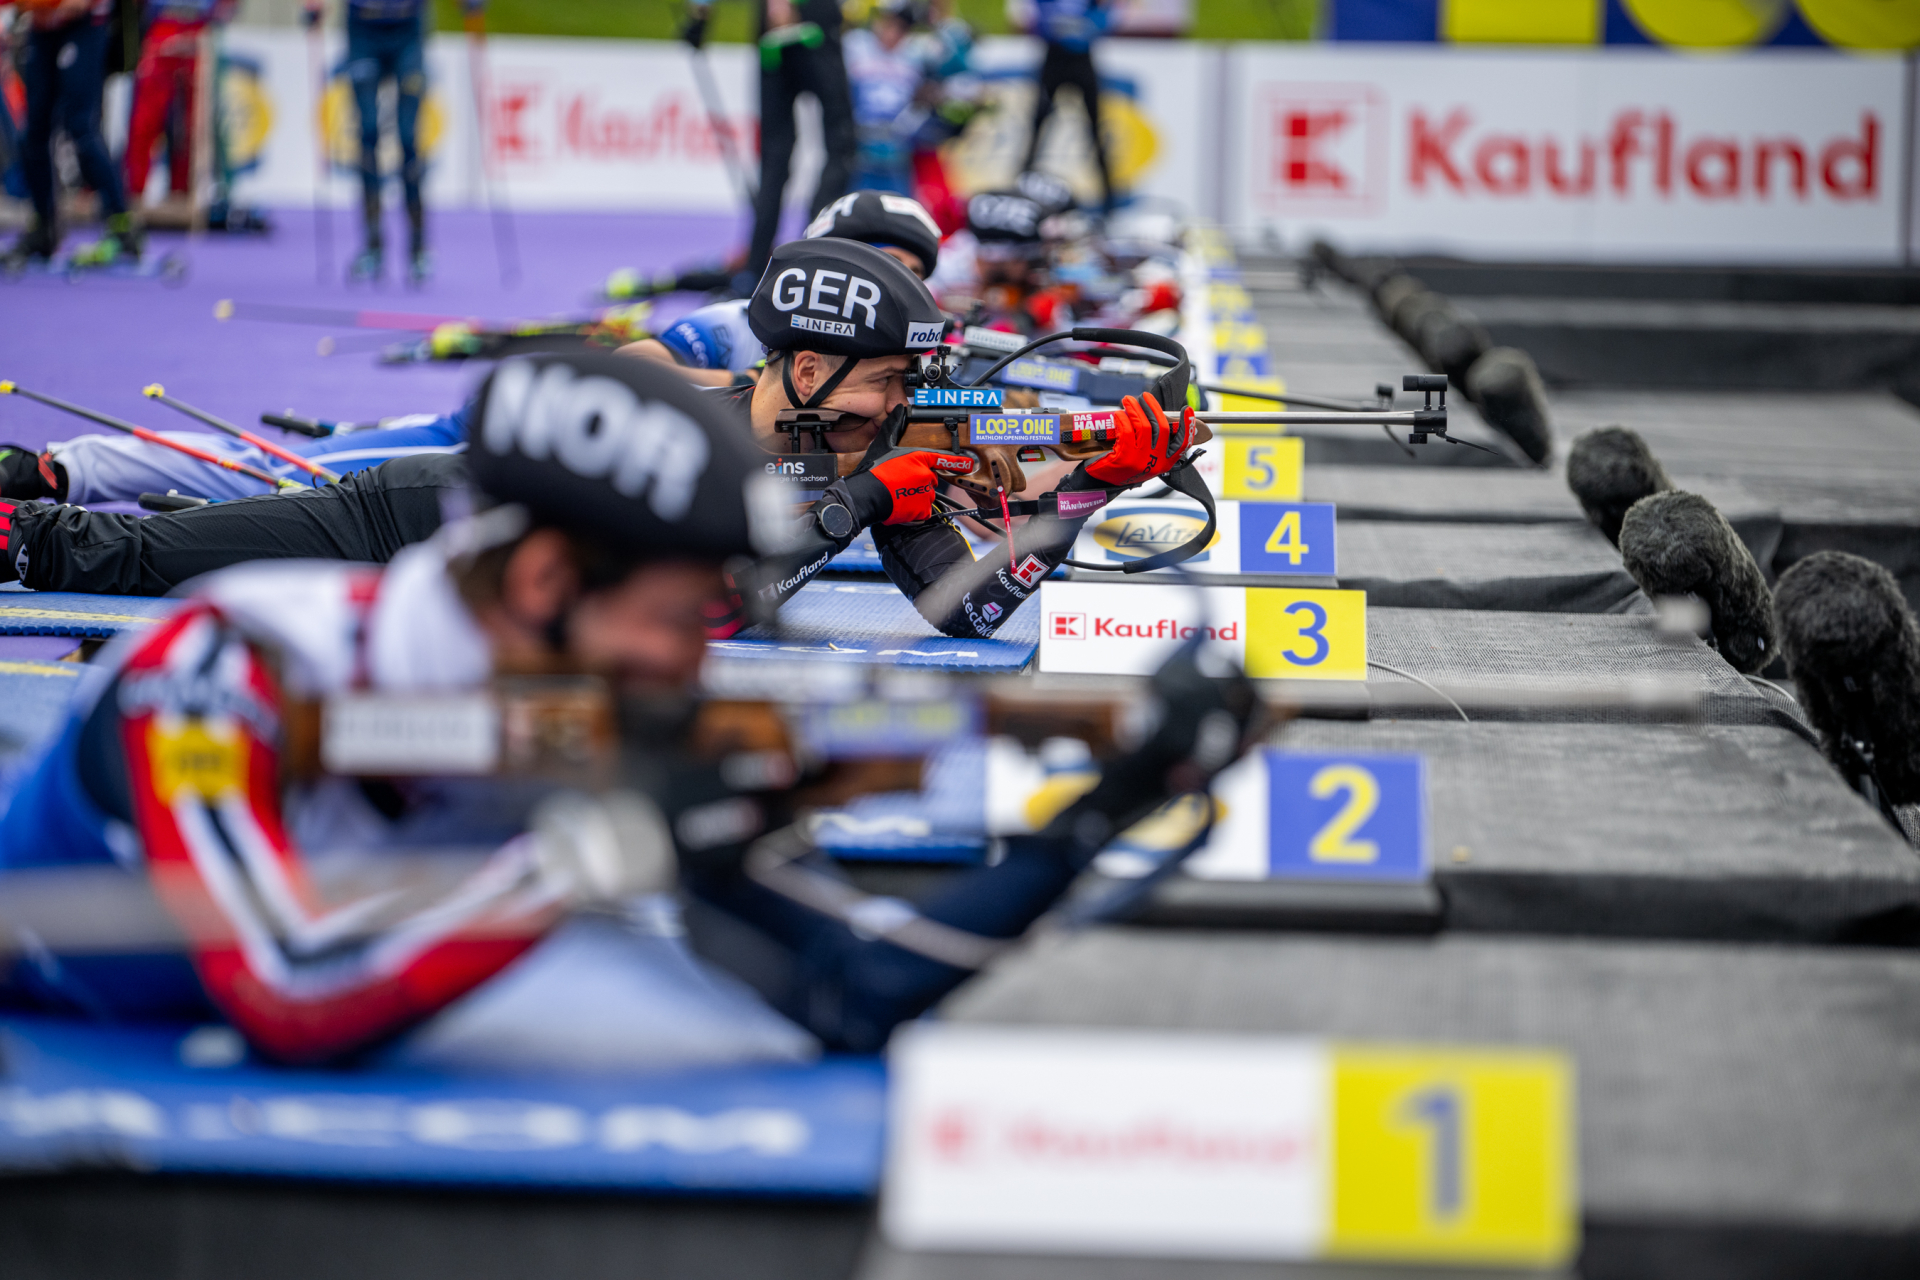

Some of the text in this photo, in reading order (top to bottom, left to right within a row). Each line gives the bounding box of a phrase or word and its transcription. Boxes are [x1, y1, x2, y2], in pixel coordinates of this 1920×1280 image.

[1404, 106, 1883, 200] Kaufland
[772, 267, 881, 330] GER
[482, 360, 709, 521] NOR
[976, 418, 1053, 435] LOOP ONE
[1073, 414, 1092, 422] DAS
[765, 458, 805, 474] eins
[1246, 446, 1278, 490] 5
[1266, 511, 1309, 564] 4
[776, 551, 829, 594] Kaufland
[1095, 617, 1237, 641] Kaufland
[1281, 600, 1329, 666] 3
[1309, 764, 1379, 863] 2
[1385, 1084, 1466, 1226] 1
